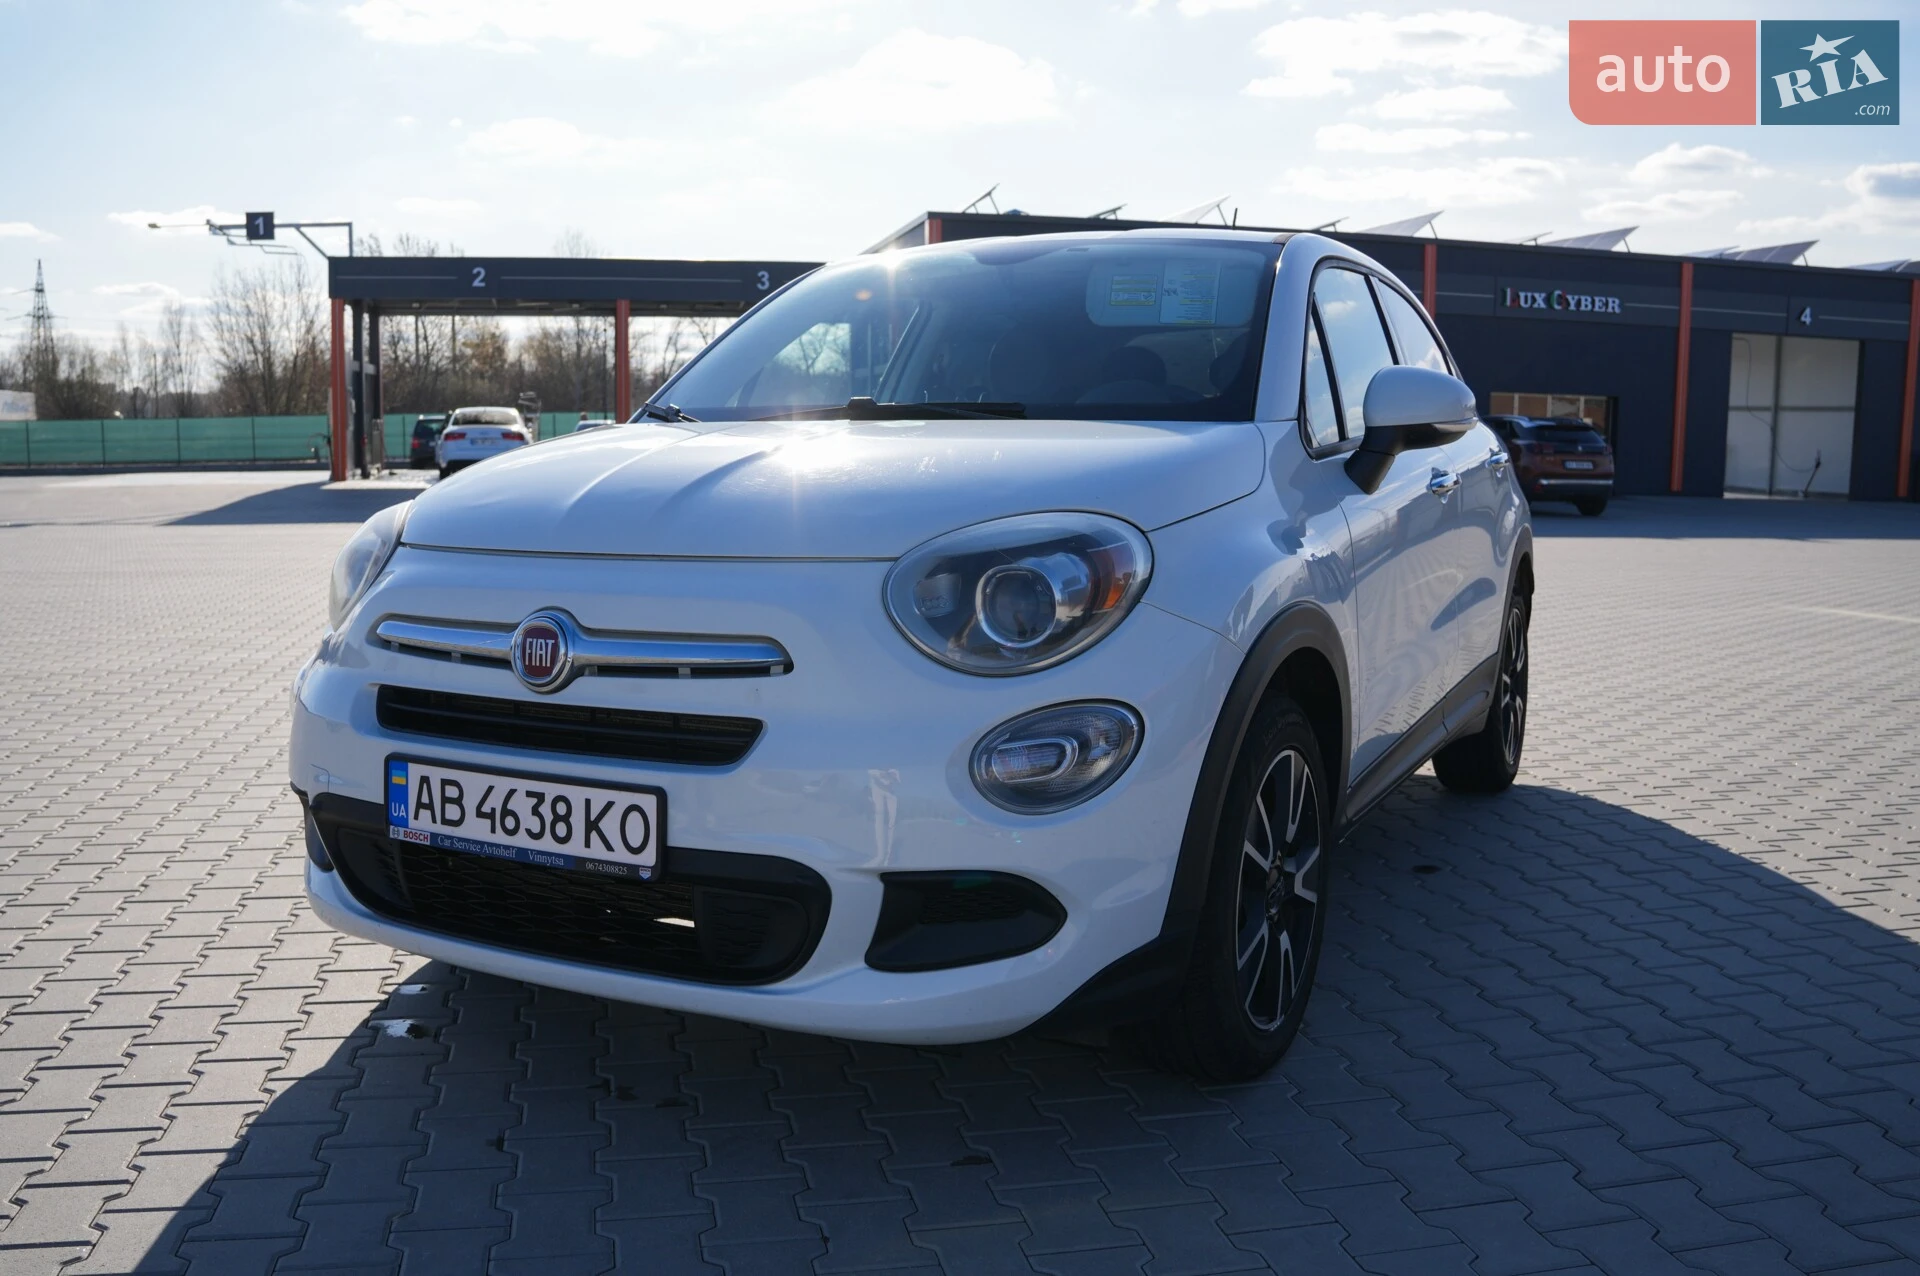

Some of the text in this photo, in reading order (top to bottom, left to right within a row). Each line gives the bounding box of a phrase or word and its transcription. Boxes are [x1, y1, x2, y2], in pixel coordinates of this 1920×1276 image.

[254, 216, 264, 236] 1
[472, 267, 486, 287] 2
[756, 270, 770, 290] 3
[1504, 287, 1621, 314] LUX CYBER
[1800, 306, 1812, 326] 4
[525, 638, 555, 667] FIAT
[391, 802, 407, 819] UA
[403, 830, 429, 842] BOSCH
[437, 835, 452, 846] Car
[453, 838, 481, 852] Service
[528, 850, 564, 866] Vinnytsa
[585, 861, 628, 875] 0674308825
